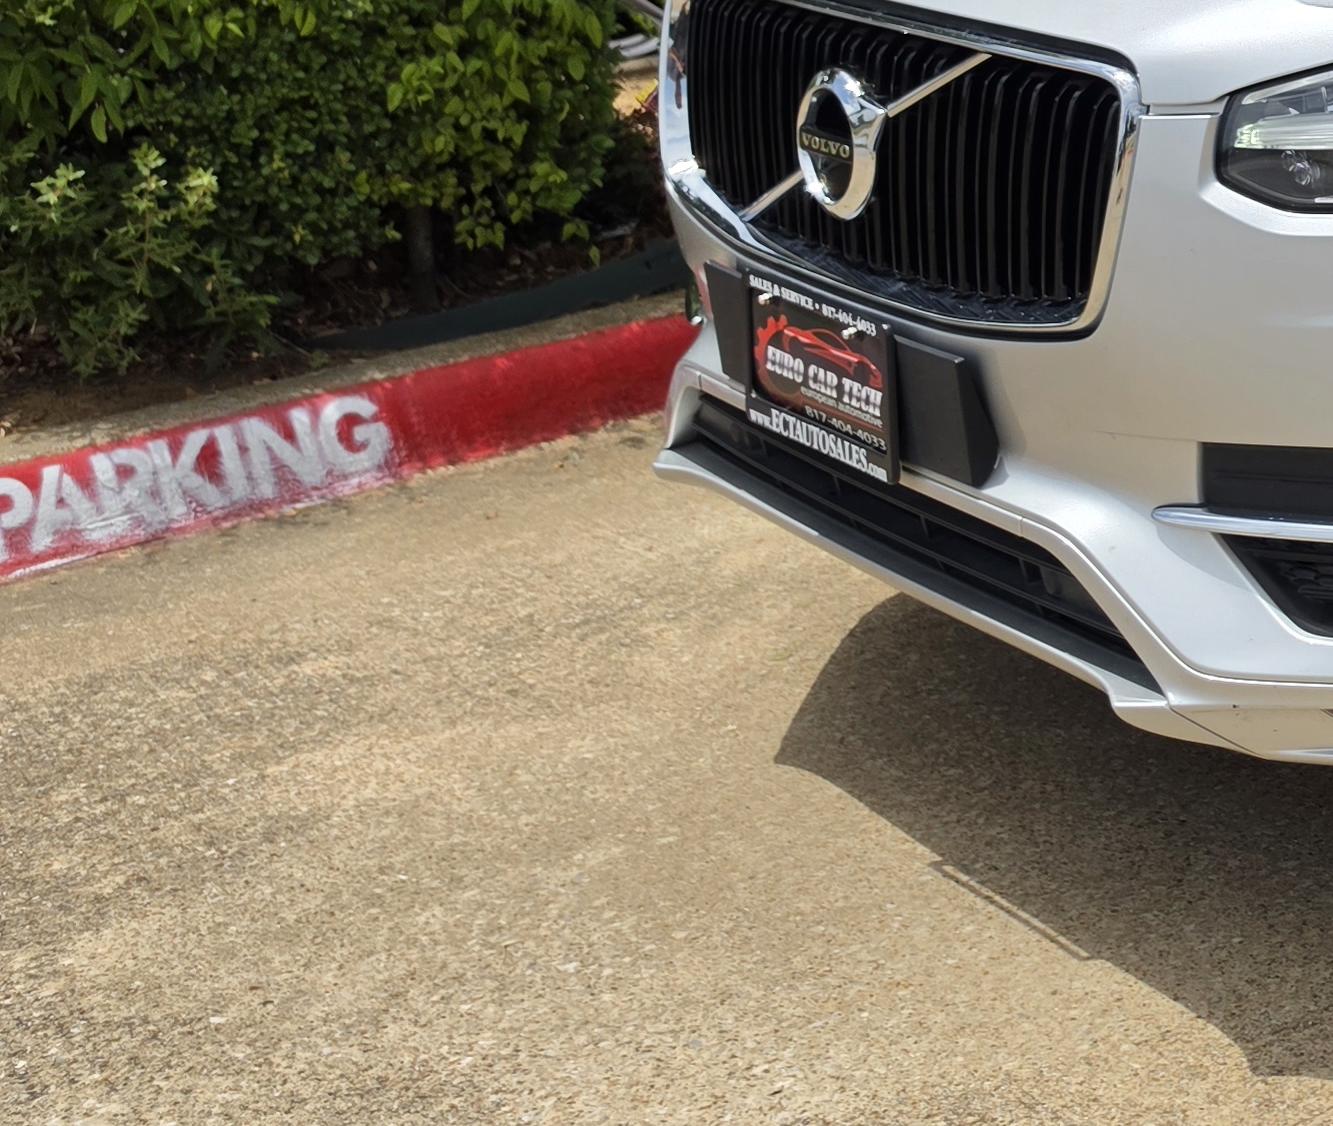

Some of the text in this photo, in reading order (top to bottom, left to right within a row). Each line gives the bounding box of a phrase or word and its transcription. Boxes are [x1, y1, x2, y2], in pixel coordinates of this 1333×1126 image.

[801, 131, 850, 159] VOLVO
[749, 274, 772, 292] SALES
[781, 286, 814, 310] SERVICE
[766, 345, 883, 417] EURO CAR TECH
[749, 408, 887, 483] www.ECTAUTOSALES.com
[805, 405, 887, 450] 817-404-4033
